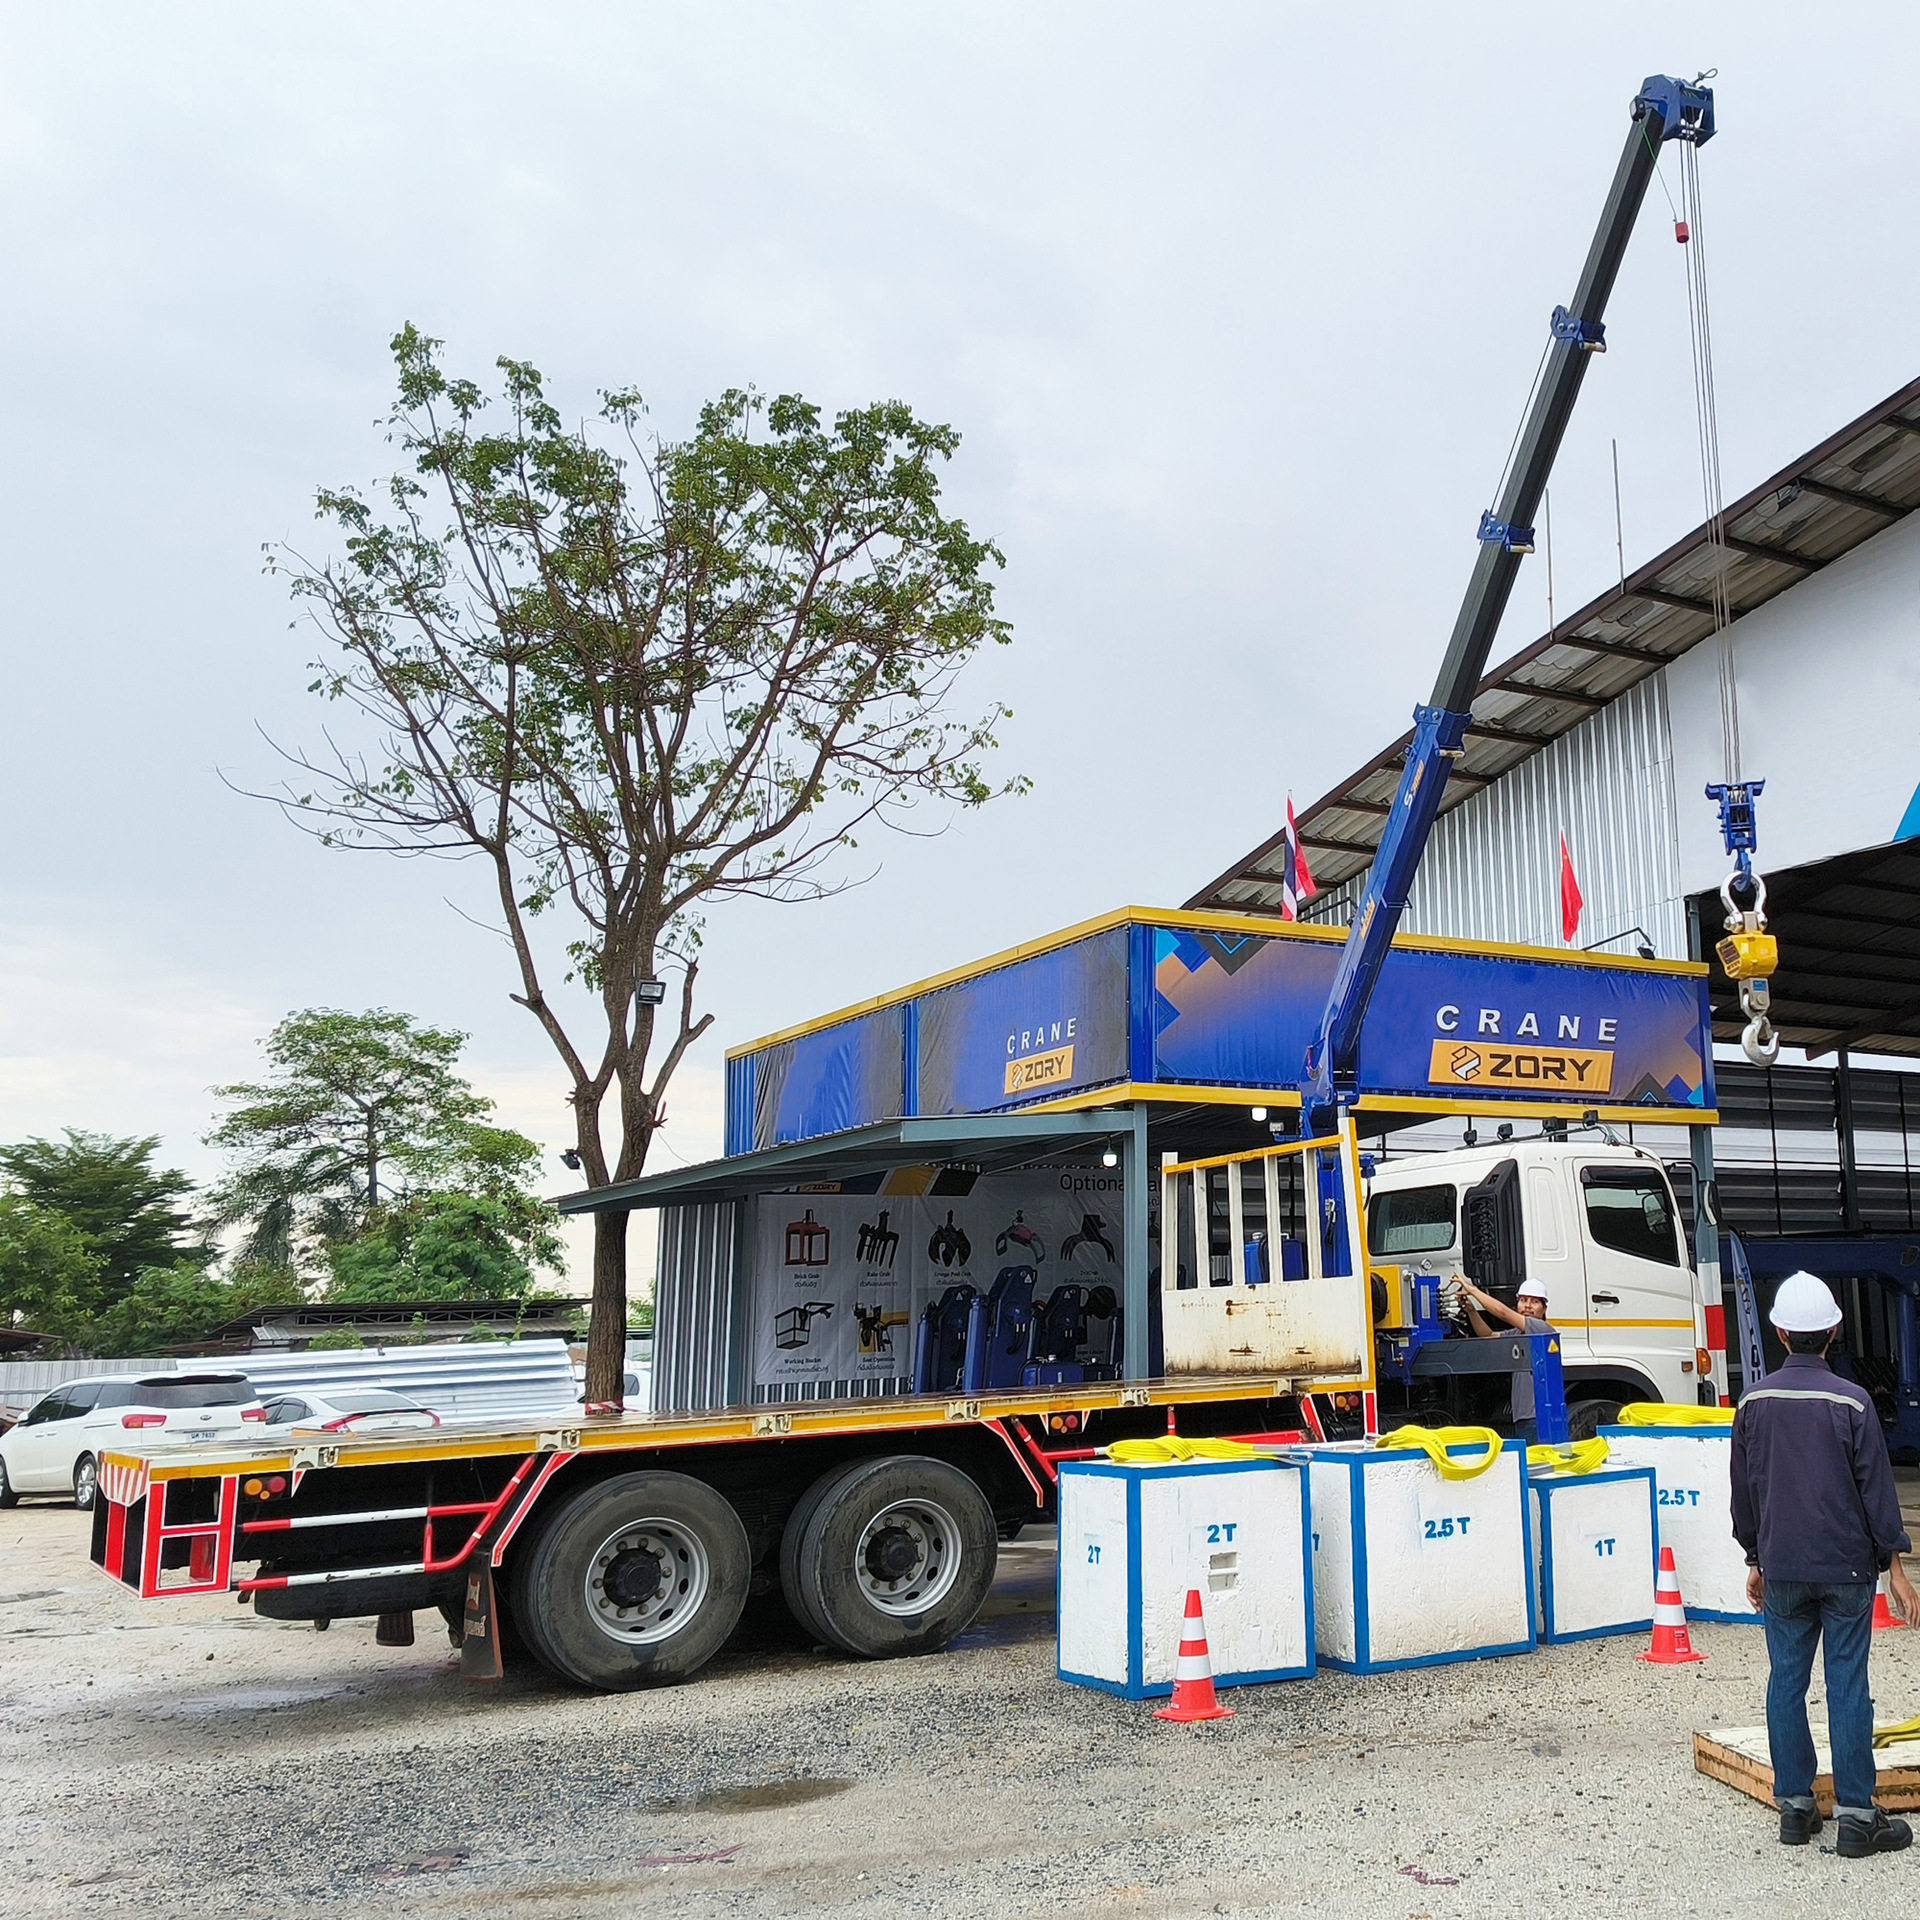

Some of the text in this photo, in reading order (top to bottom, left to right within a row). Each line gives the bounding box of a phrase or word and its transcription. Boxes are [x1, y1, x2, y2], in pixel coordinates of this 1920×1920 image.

[1435, 1004, 1619, 1043] CRANE
[1006, 1016, 1078, 1055] CRANE
[1024, 1054, 1066, 1083] ZORY
[1489, 1053, 1594, 1082] ZORY
[812, 1183, 836, 1191] ZORY
[1060, 1173, 1125, 1195] Optiona
[1206, 1522, 1237, 1543] 2T
[1086, 1544, 1101, 1565] 2T
[1594, 1538, 1616, 1557] 1T
